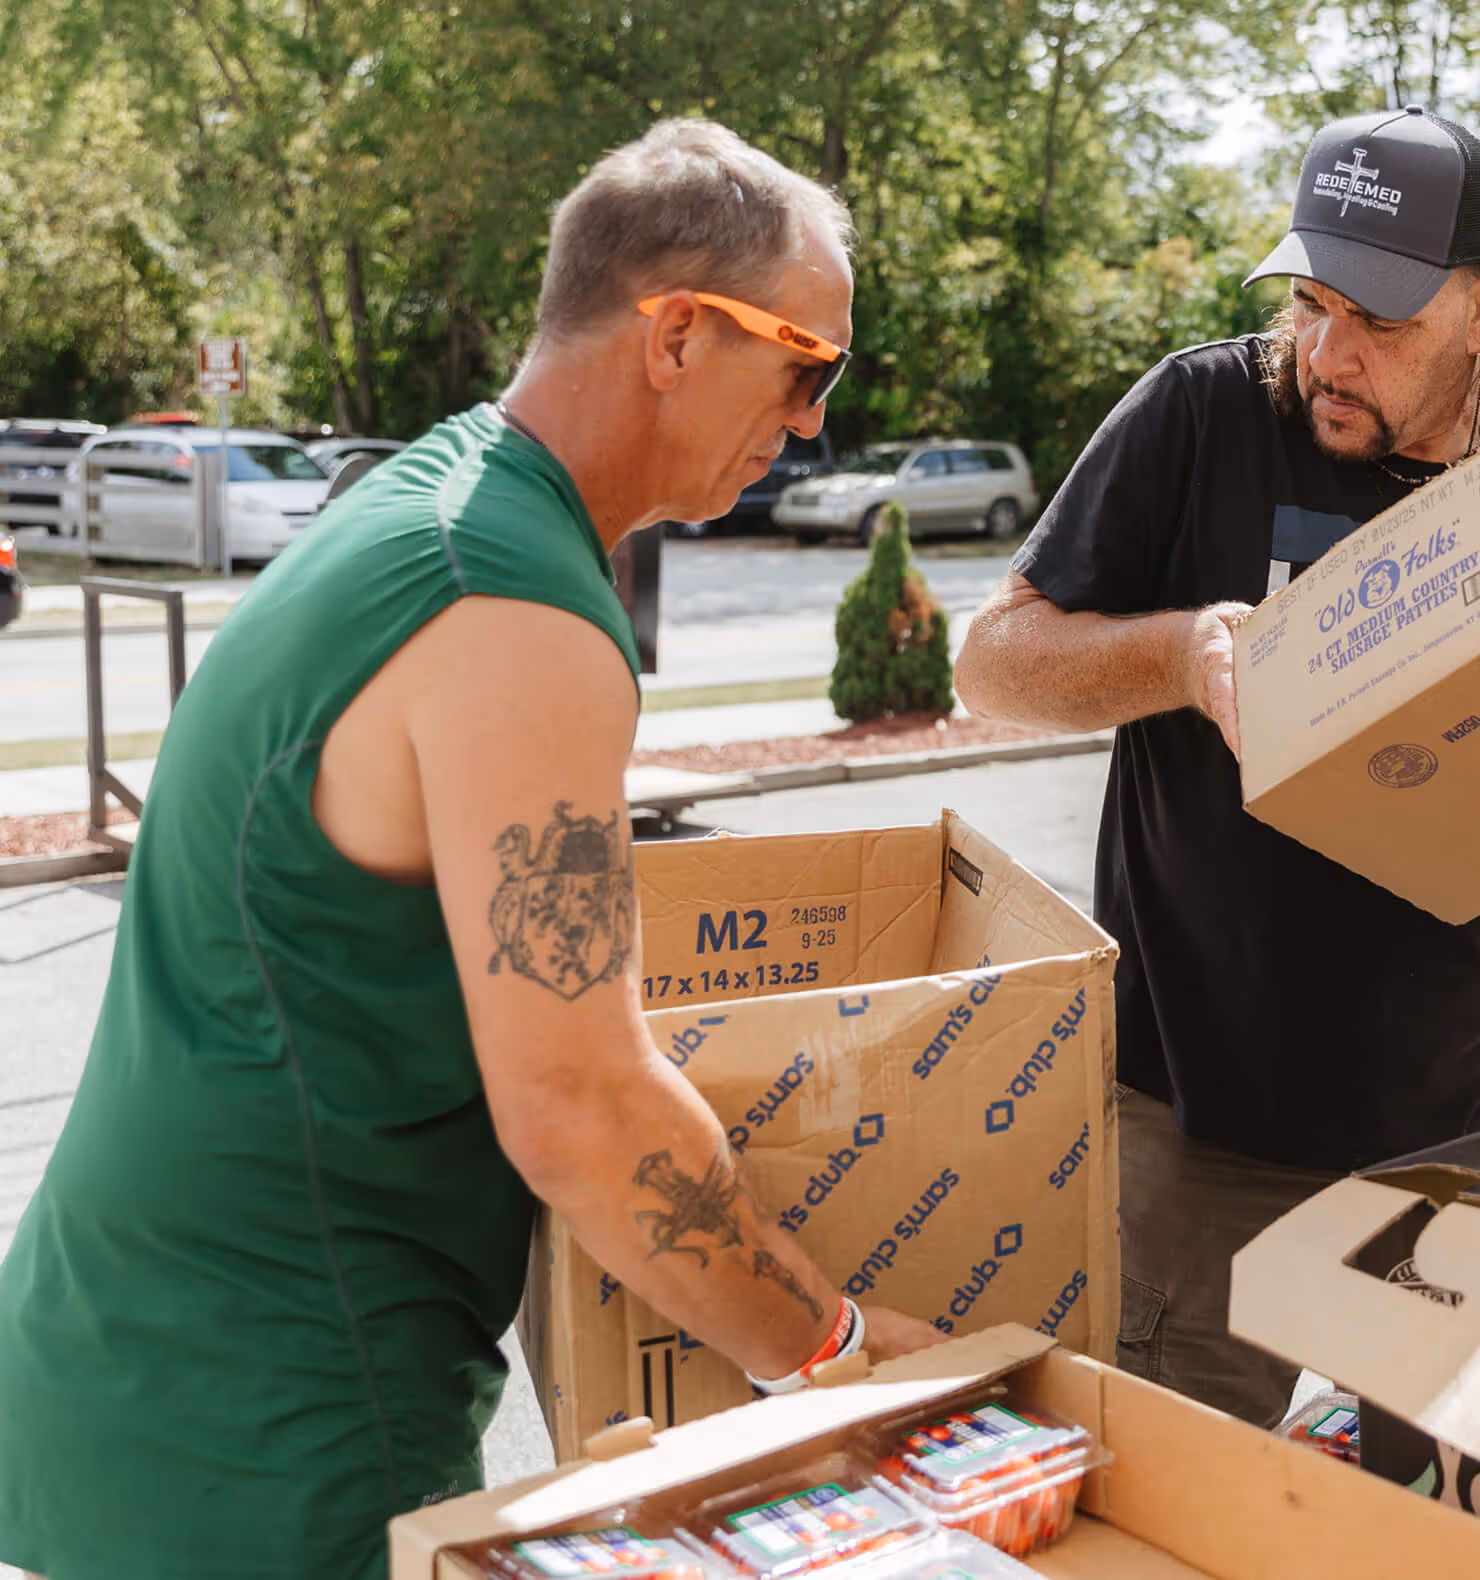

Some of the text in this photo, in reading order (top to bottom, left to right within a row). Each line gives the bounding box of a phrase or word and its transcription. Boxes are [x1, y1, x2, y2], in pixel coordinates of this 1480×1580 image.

[1315, 172, 1401, 204] REDEEMED
[1307, 652, 1323, 675] 24
[1326, 638, 1342, 661] CT
[1347, 596, 1407, 646] MEDIUM
[1411, 550, 1480, 603] COUNTRY
[1331, 622, 1392, 675] SAUSAGE
[1396, 581, 1458, 632] PATTIES
[696, 909, 769, 954] M2
[791, 904, 847, 925] 246598
[801, 928, 837, 949] 9-25
[643, 960, 820, 998] 17 x 14 x 13.25
[911, 1002, 973, 1081] sam's
[1009, 1039, 1057, 1099] club
[745, 1051, 815, 1129] sam's
[804, 1148, 861, 1207] club
[893, 1167, 961, 1241] sam's
[845, 1238, 898, 1296] club
[949, 1258, 1001, 1318] club
